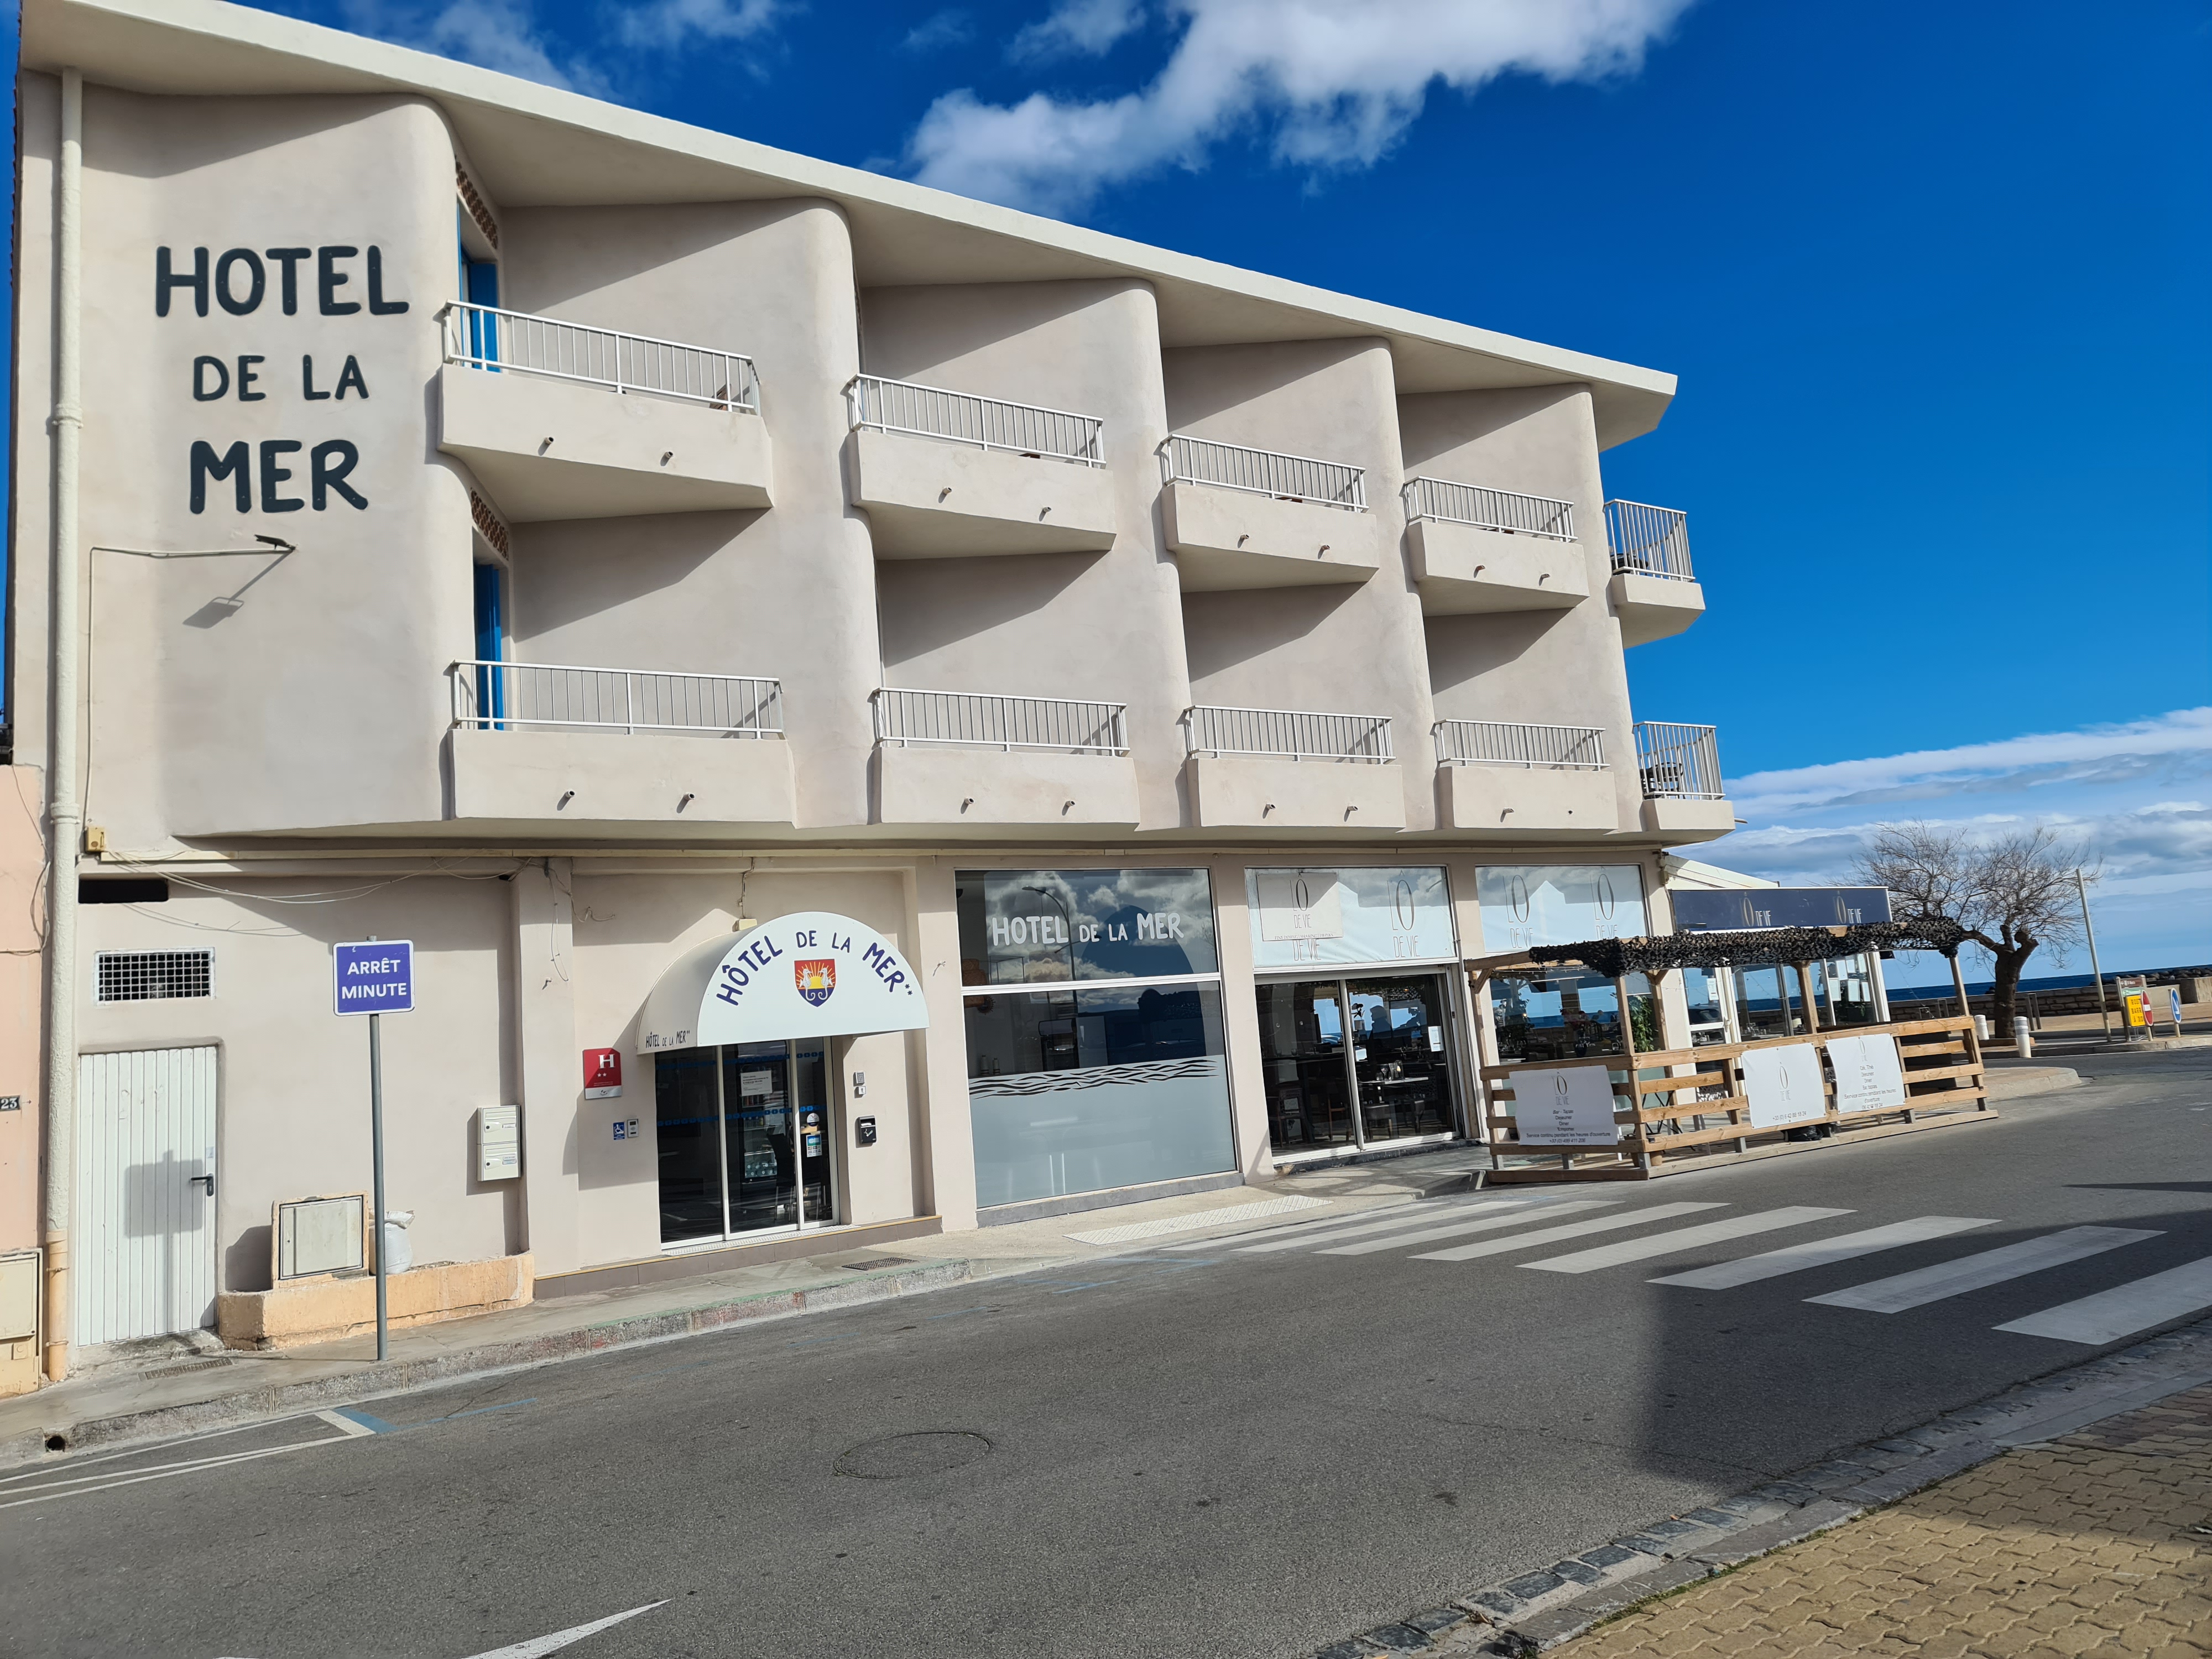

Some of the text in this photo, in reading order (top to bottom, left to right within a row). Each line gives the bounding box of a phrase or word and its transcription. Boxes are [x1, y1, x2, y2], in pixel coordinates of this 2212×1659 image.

[156, 245, 409, 317] HOTEL
[193, 354, 369, 401] DE LA
[190, 440, 368, 514] MER
[1294, 914, 1312, 928] DE VIE
[1755, 911, 1762, 927] DE
[1848, 909, 1854, 924] DE
[992, 912, 1184, 946] HOTEL DE LA MER
[1510, 927, 1533, 948] DE VIE
[1292, 939, 1322, 961] DE VIE
[1394, 935, 1420, 958] DE VIE
[347, 957, 400, 975] ARRÊT
[716, 936, 782, 1005] HÔTEL
[796, 930, 817, 948] DE
[832, 932, 851, 953] LA
[342, 983, 406, 999] MINUTE
[646, 1031, 659, 1048] HÔTEL
[662, 1037, 667, 1046] DE
[670, 1036, 674, 1046] LA
[598, 1054, 615, 1069] H
[1, 1098, 17, 1109] 23
[1556, 1096, 1562, 1105] DE
